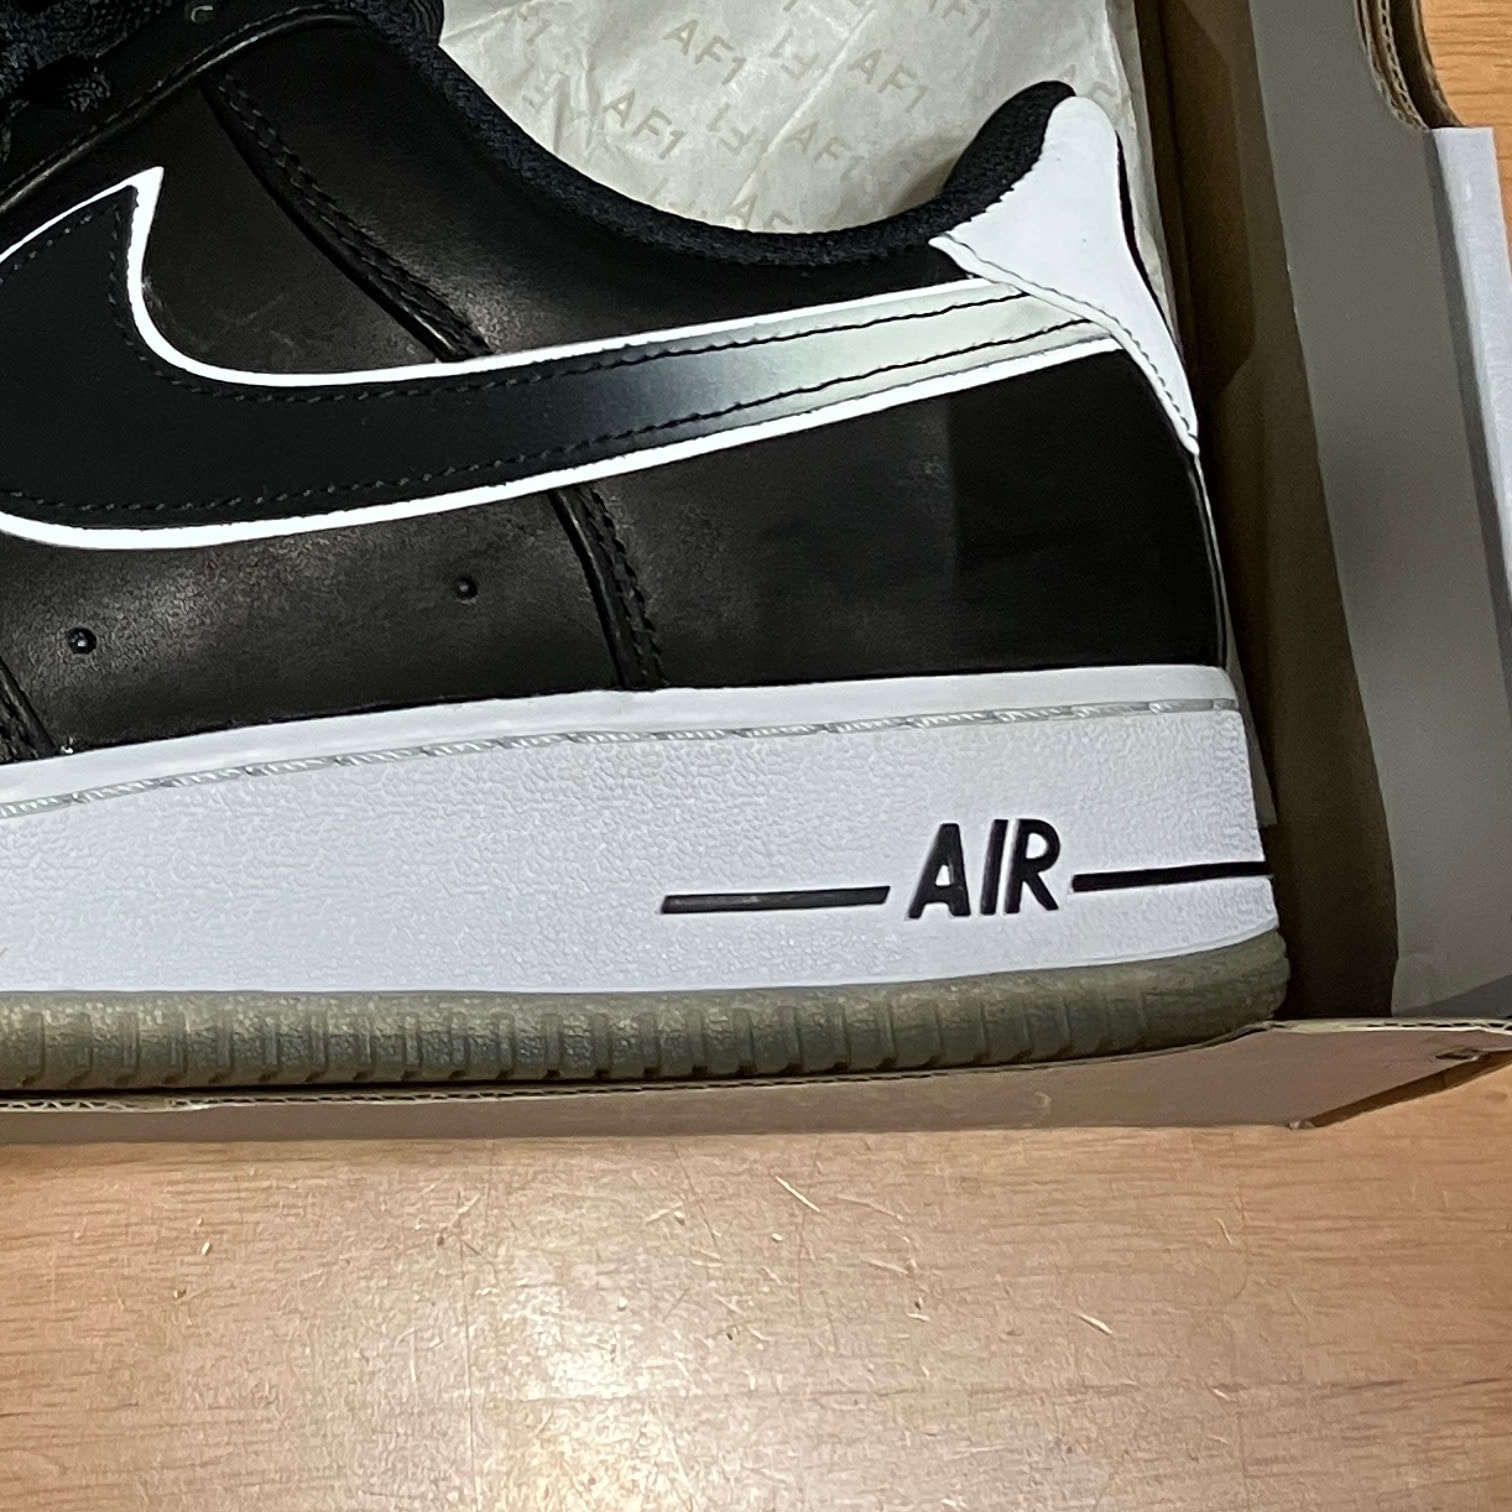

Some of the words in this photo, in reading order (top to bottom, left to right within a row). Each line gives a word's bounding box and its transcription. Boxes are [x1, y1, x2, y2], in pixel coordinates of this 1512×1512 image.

[662, 18, 747, 86] AF1
[847, 48, 929, 114] AF1
[601, 89, 686, 161] AF1
[784, 119, 867, 184] AF1
[908, 818, 1061, 919] AIR
